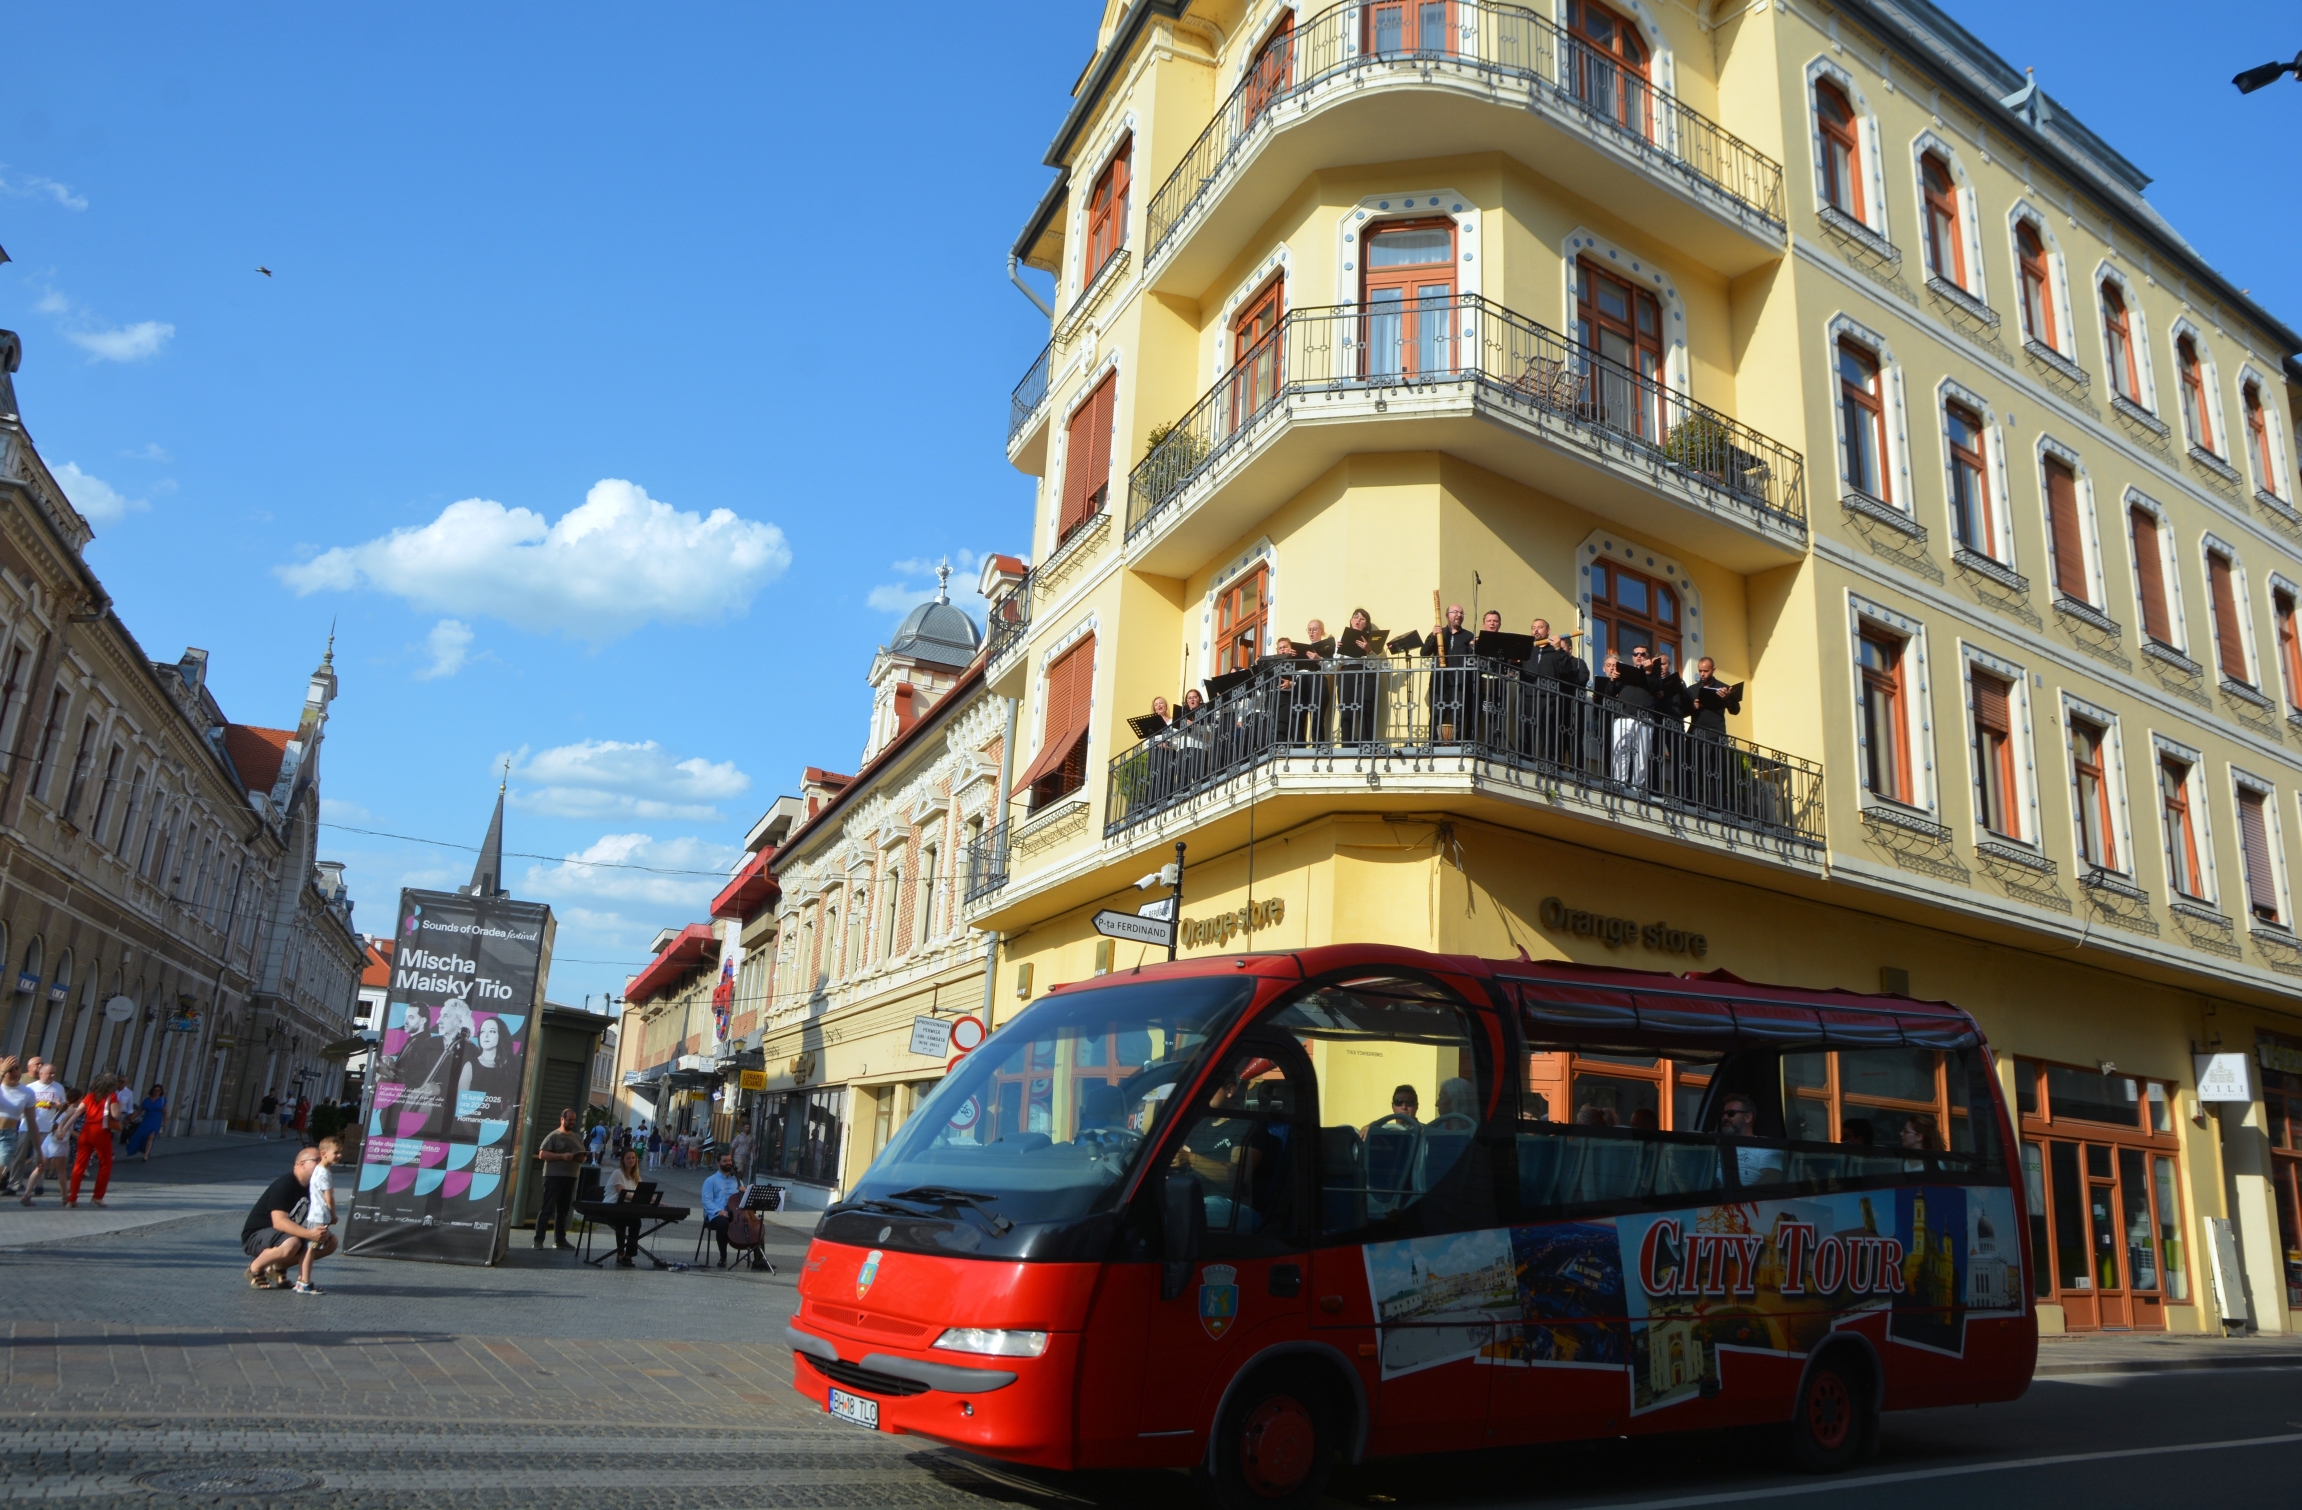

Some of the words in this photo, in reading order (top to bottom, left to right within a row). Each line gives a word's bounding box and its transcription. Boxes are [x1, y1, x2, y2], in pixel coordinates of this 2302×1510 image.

[422, 920, 459, 933] Sounds
[460, 924, 471, 934] of
[471, 925, 506, 938] Oradea
[504, 930, 538, 941] festival
[1117, 922, 1166, 938] FERDINAND
[1181, 911, 1237, 948] Orange
[1237, 897, 1285, 932] store
[1539, 896, 1639, 948] Orange
[1642, 921, 1708, 957] store
[400, 947, 476, 974] Mischa
[396, 969, 474, 1000] Maisky
[475, 977, 513, 1000] Trio
[917, 1020, 949, 1029] APROVIZIONAREA
[743, 1072, 763, 1082] LORAND
[470, 1101, 490, 1109] 20:30
[484, 1095, 502, 1103] 2025
[458, 1108, 482, 1116] Bazilica
[368, 1139, 384, 1147] Bilete
[384, 1141, 412, 1149] disponibile
[419, 1144, 441, 1152] bilete.ro
[380, 1148, 422, 1156] soundsoforadea
[1638, 1217, 1764, 1297] CITY
[1777, 1221, 1905, 1295] TOUR
[834, 1391, 845, 1412] BH
[847, 1397, 855, 1415] 18
[859, 1400, 877, 1422] TLO
